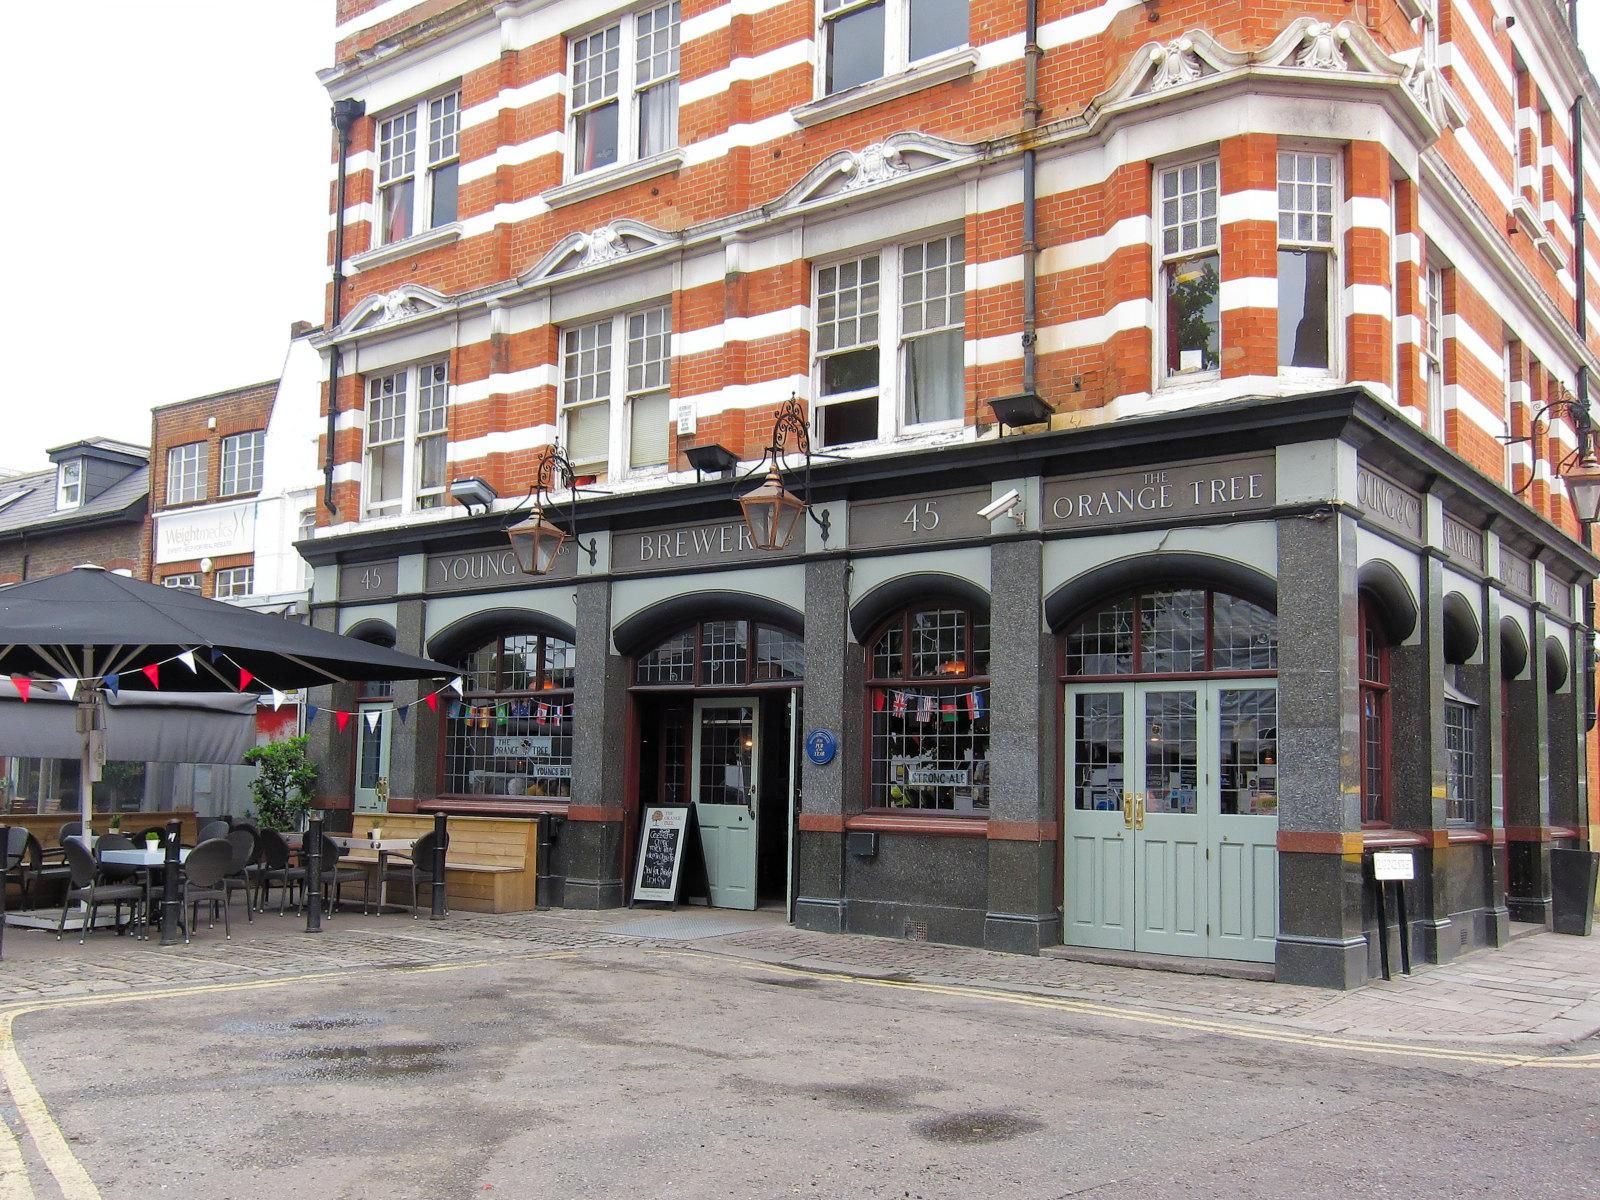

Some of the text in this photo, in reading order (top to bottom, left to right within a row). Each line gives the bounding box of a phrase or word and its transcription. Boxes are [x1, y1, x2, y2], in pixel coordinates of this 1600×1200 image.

[1143, 471, 1169, 485] THE
[1053, 474, 1264, 519] ORANGE TREE
[1357, 471, 1394, 520] OUNG
[902, 501, 940, 533] 45
[440, 552, 516, 582] YOUNG
[361, 568, 382, 590] 45
[498, 738, 511, 746] THE
[532, 746, 549, 755] TREE
[912, 772, 966, 784] STRONG ALE
